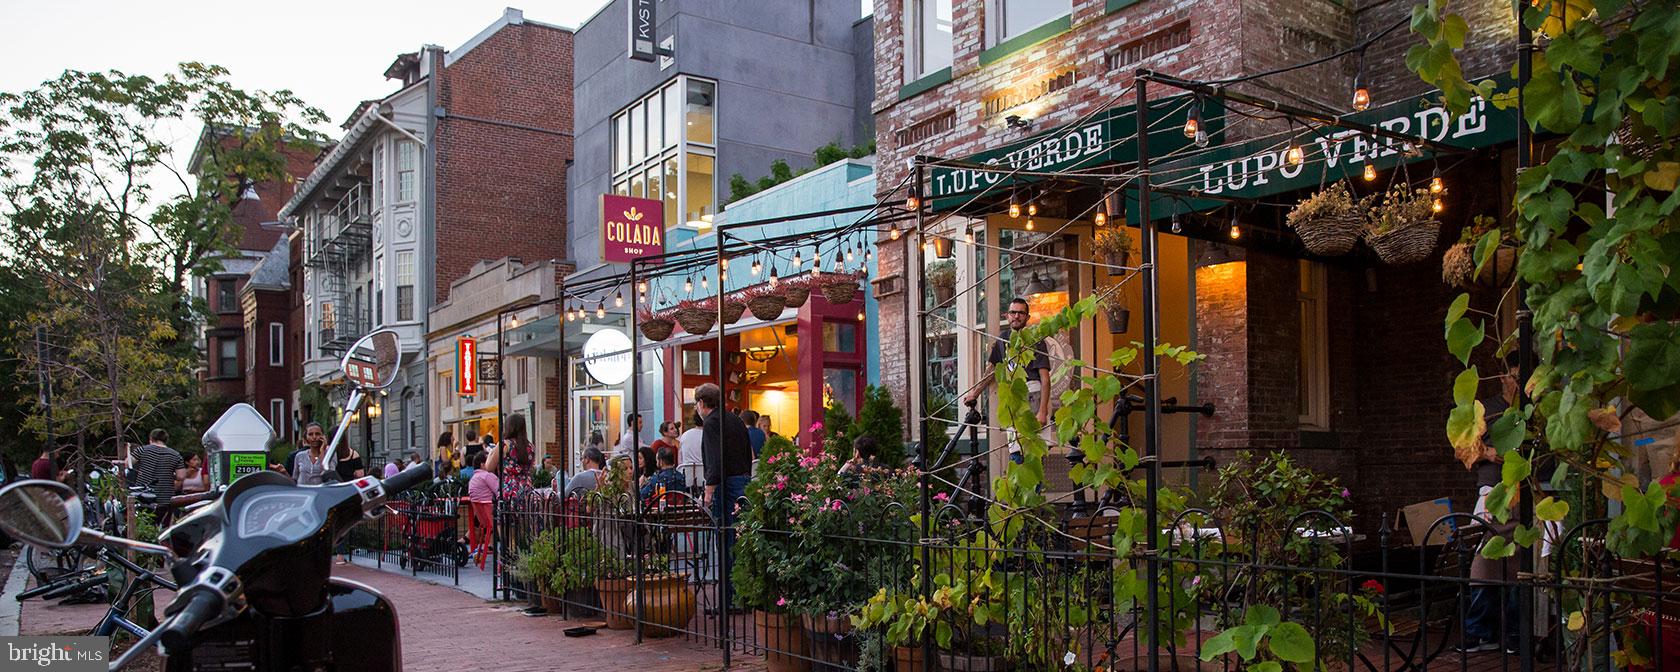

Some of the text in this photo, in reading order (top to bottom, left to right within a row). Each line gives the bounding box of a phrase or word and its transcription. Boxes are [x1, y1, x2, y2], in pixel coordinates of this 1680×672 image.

[936, 124, 1102, 195] LUPO VERDE
[1200, 95, 1487, 194] LUPO VERDE
[607, 221, 661, 247] COLADA
[624, 247, 644, 255] SHOP
